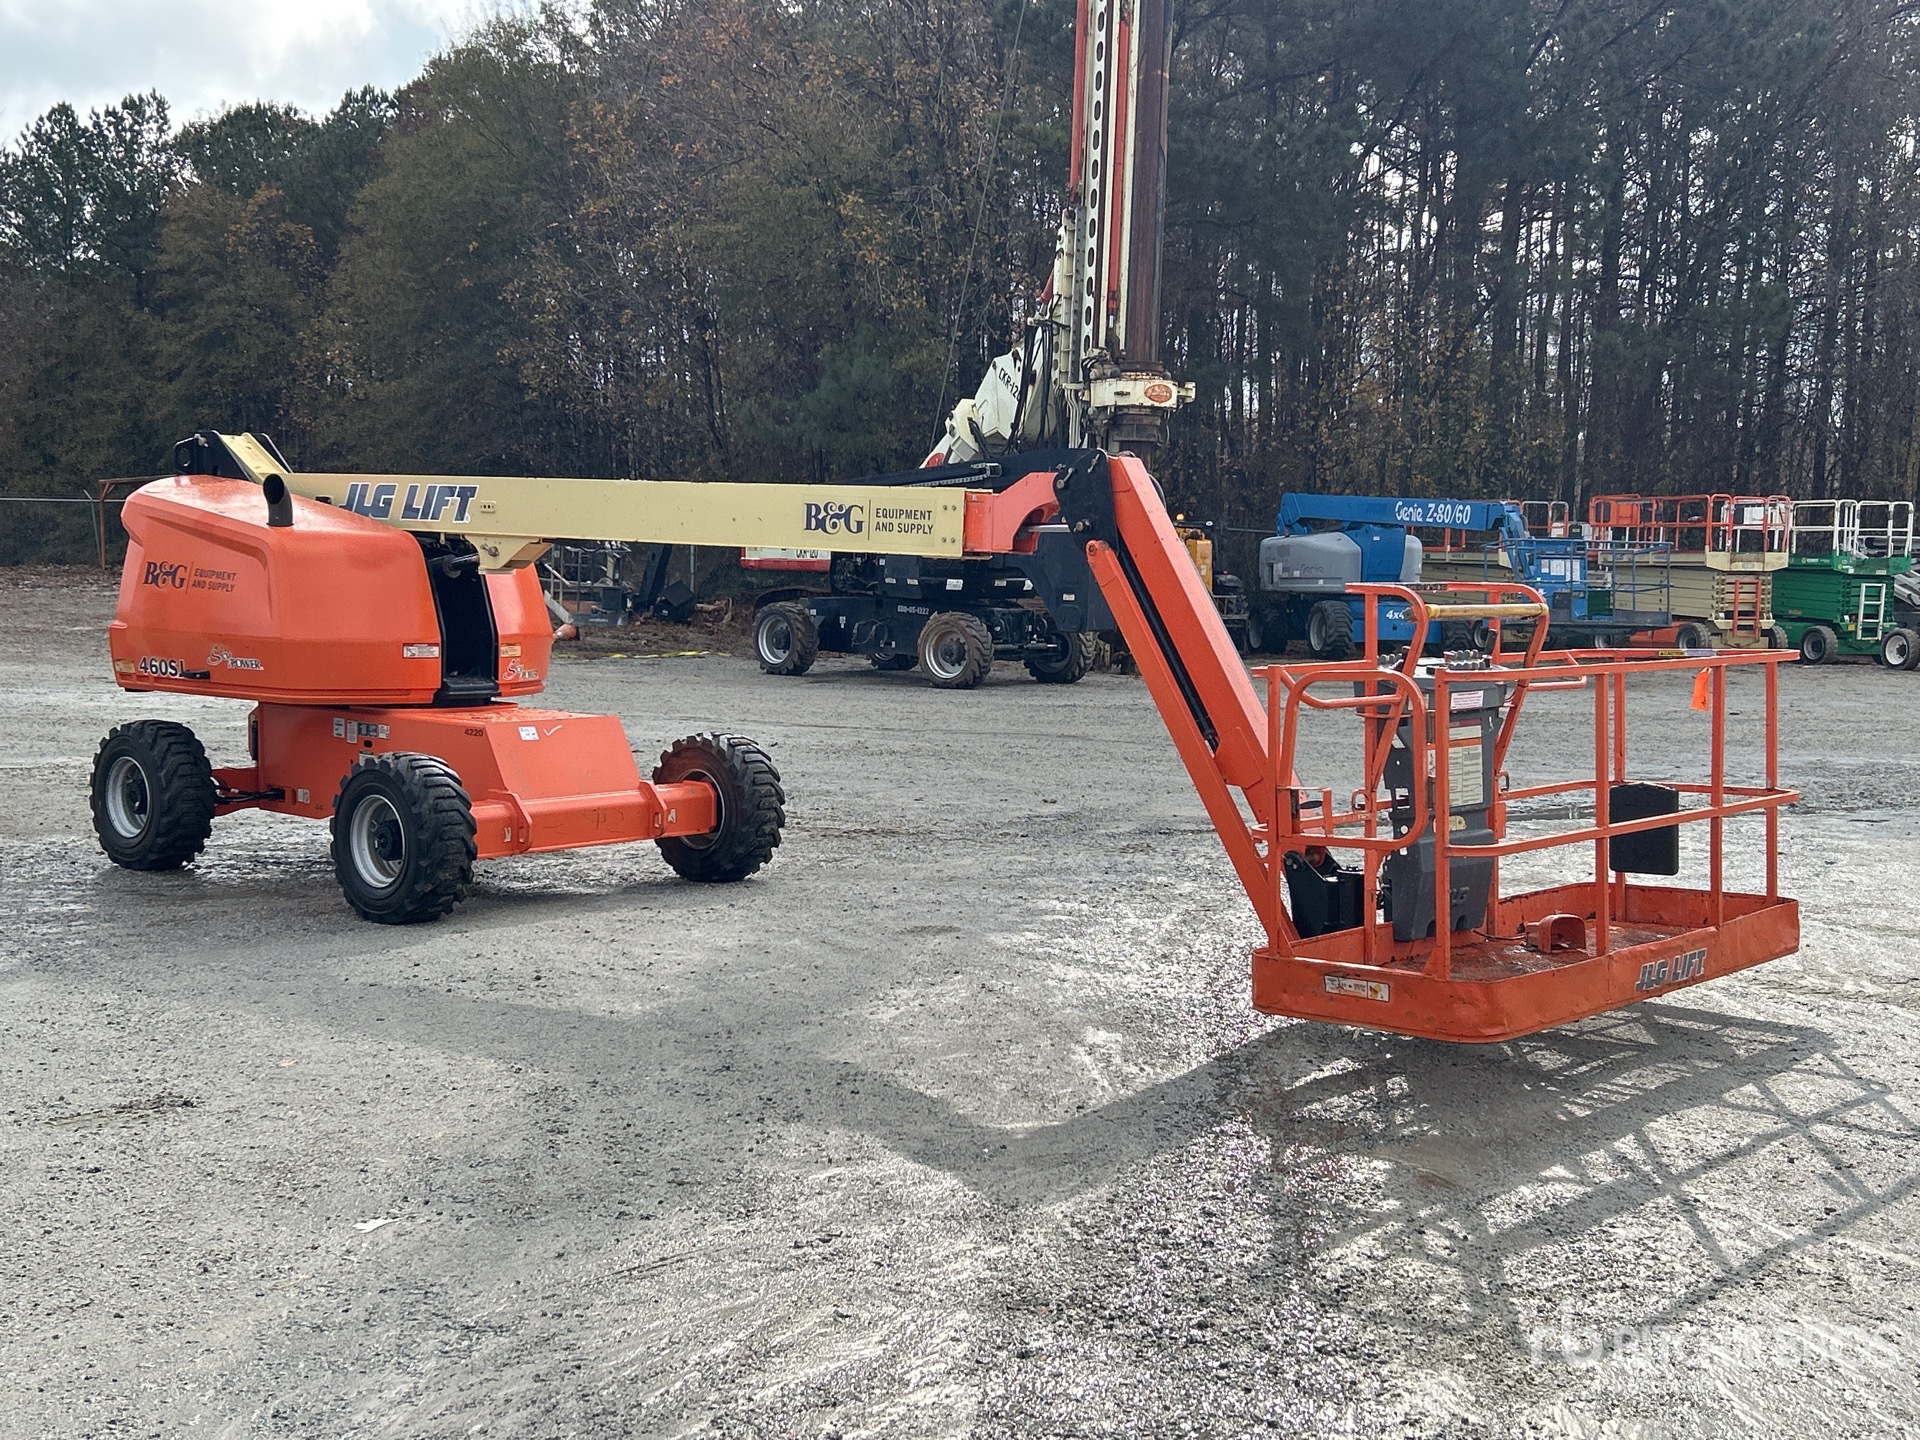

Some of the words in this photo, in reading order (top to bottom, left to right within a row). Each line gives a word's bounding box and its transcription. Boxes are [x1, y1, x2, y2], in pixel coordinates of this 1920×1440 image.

[339, 482, 398, 520] JLG
[400, 483, 479, 523] LIFT
[804, 501, 865, 534] B&G
[875, 507, 932, 521] EQUIPMENT
[1395, 500, 1423, 522] Genie
[1426, 502, 1472, 525] Z-80/60
[875, 521, 894, 532] AND
[897, 522, 934, 535] SUPPLY
[142, 560, 188, 591] B&G
[194, 568, 237, 582] EQUIPMENT
[192, 579, 205, 590] AND
[207, 581, 236, 593] SUPPLY
[464, 727, 484, 737] 4220
[1634, 959, 1669, 992] JLG
[1671, 948, 1707, 983] LIFT
